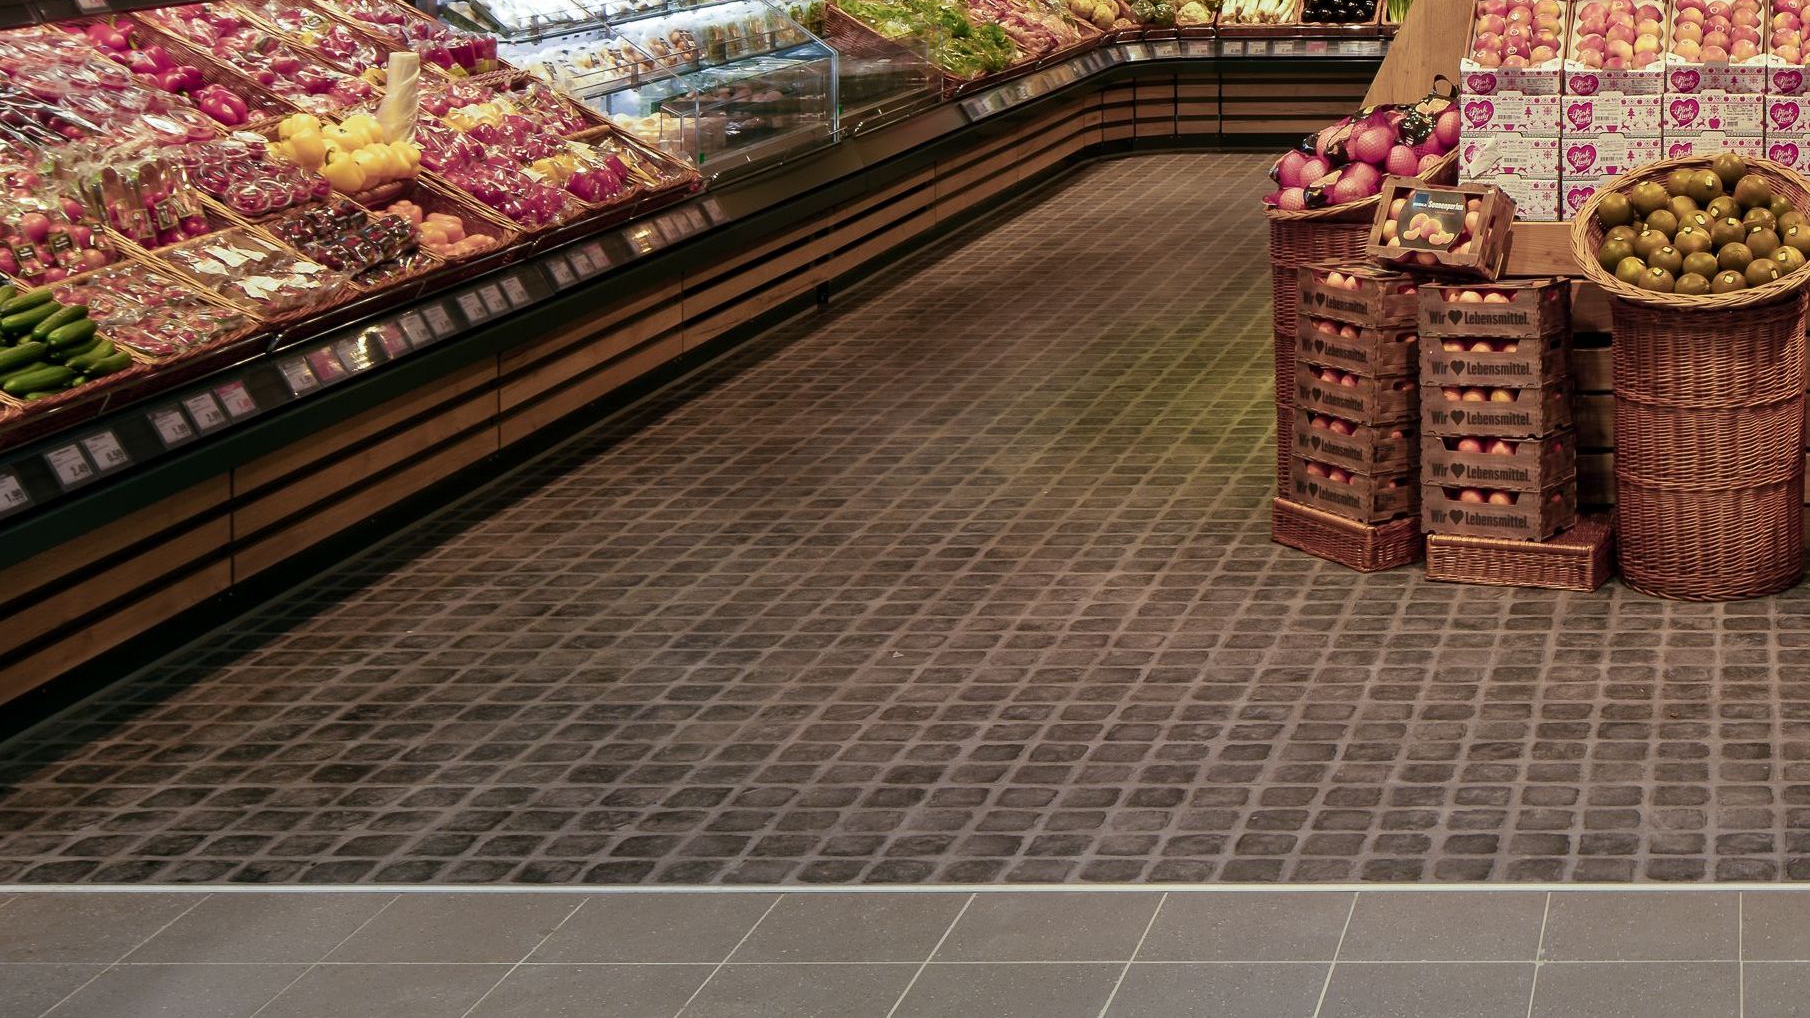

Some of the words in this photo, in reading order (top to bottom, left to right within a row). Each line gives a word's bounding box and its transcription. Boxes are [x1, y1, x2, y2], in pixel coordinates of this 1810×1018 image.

[1470, 105, 1488, 117] Pink
[1430, 311, 1446, 324] Wir
[1464, 311, 1530, 325] Lebensmittel.
[1432, 361, 1449, 375] Wir
[1467, 362, 1533, 375] Lebensmittel.
[1431, 411, 1448, 425] Wir
[1466, 412, 1532, 425] Lebensmittel.
[1431, 463, 1449, 477] Wir
[1466, 465, 1531, 482] Lebensmittel.
[1430, 510, 1447, 524] Wir
[1465, 512, 1530, 529] Lebensmittel.
